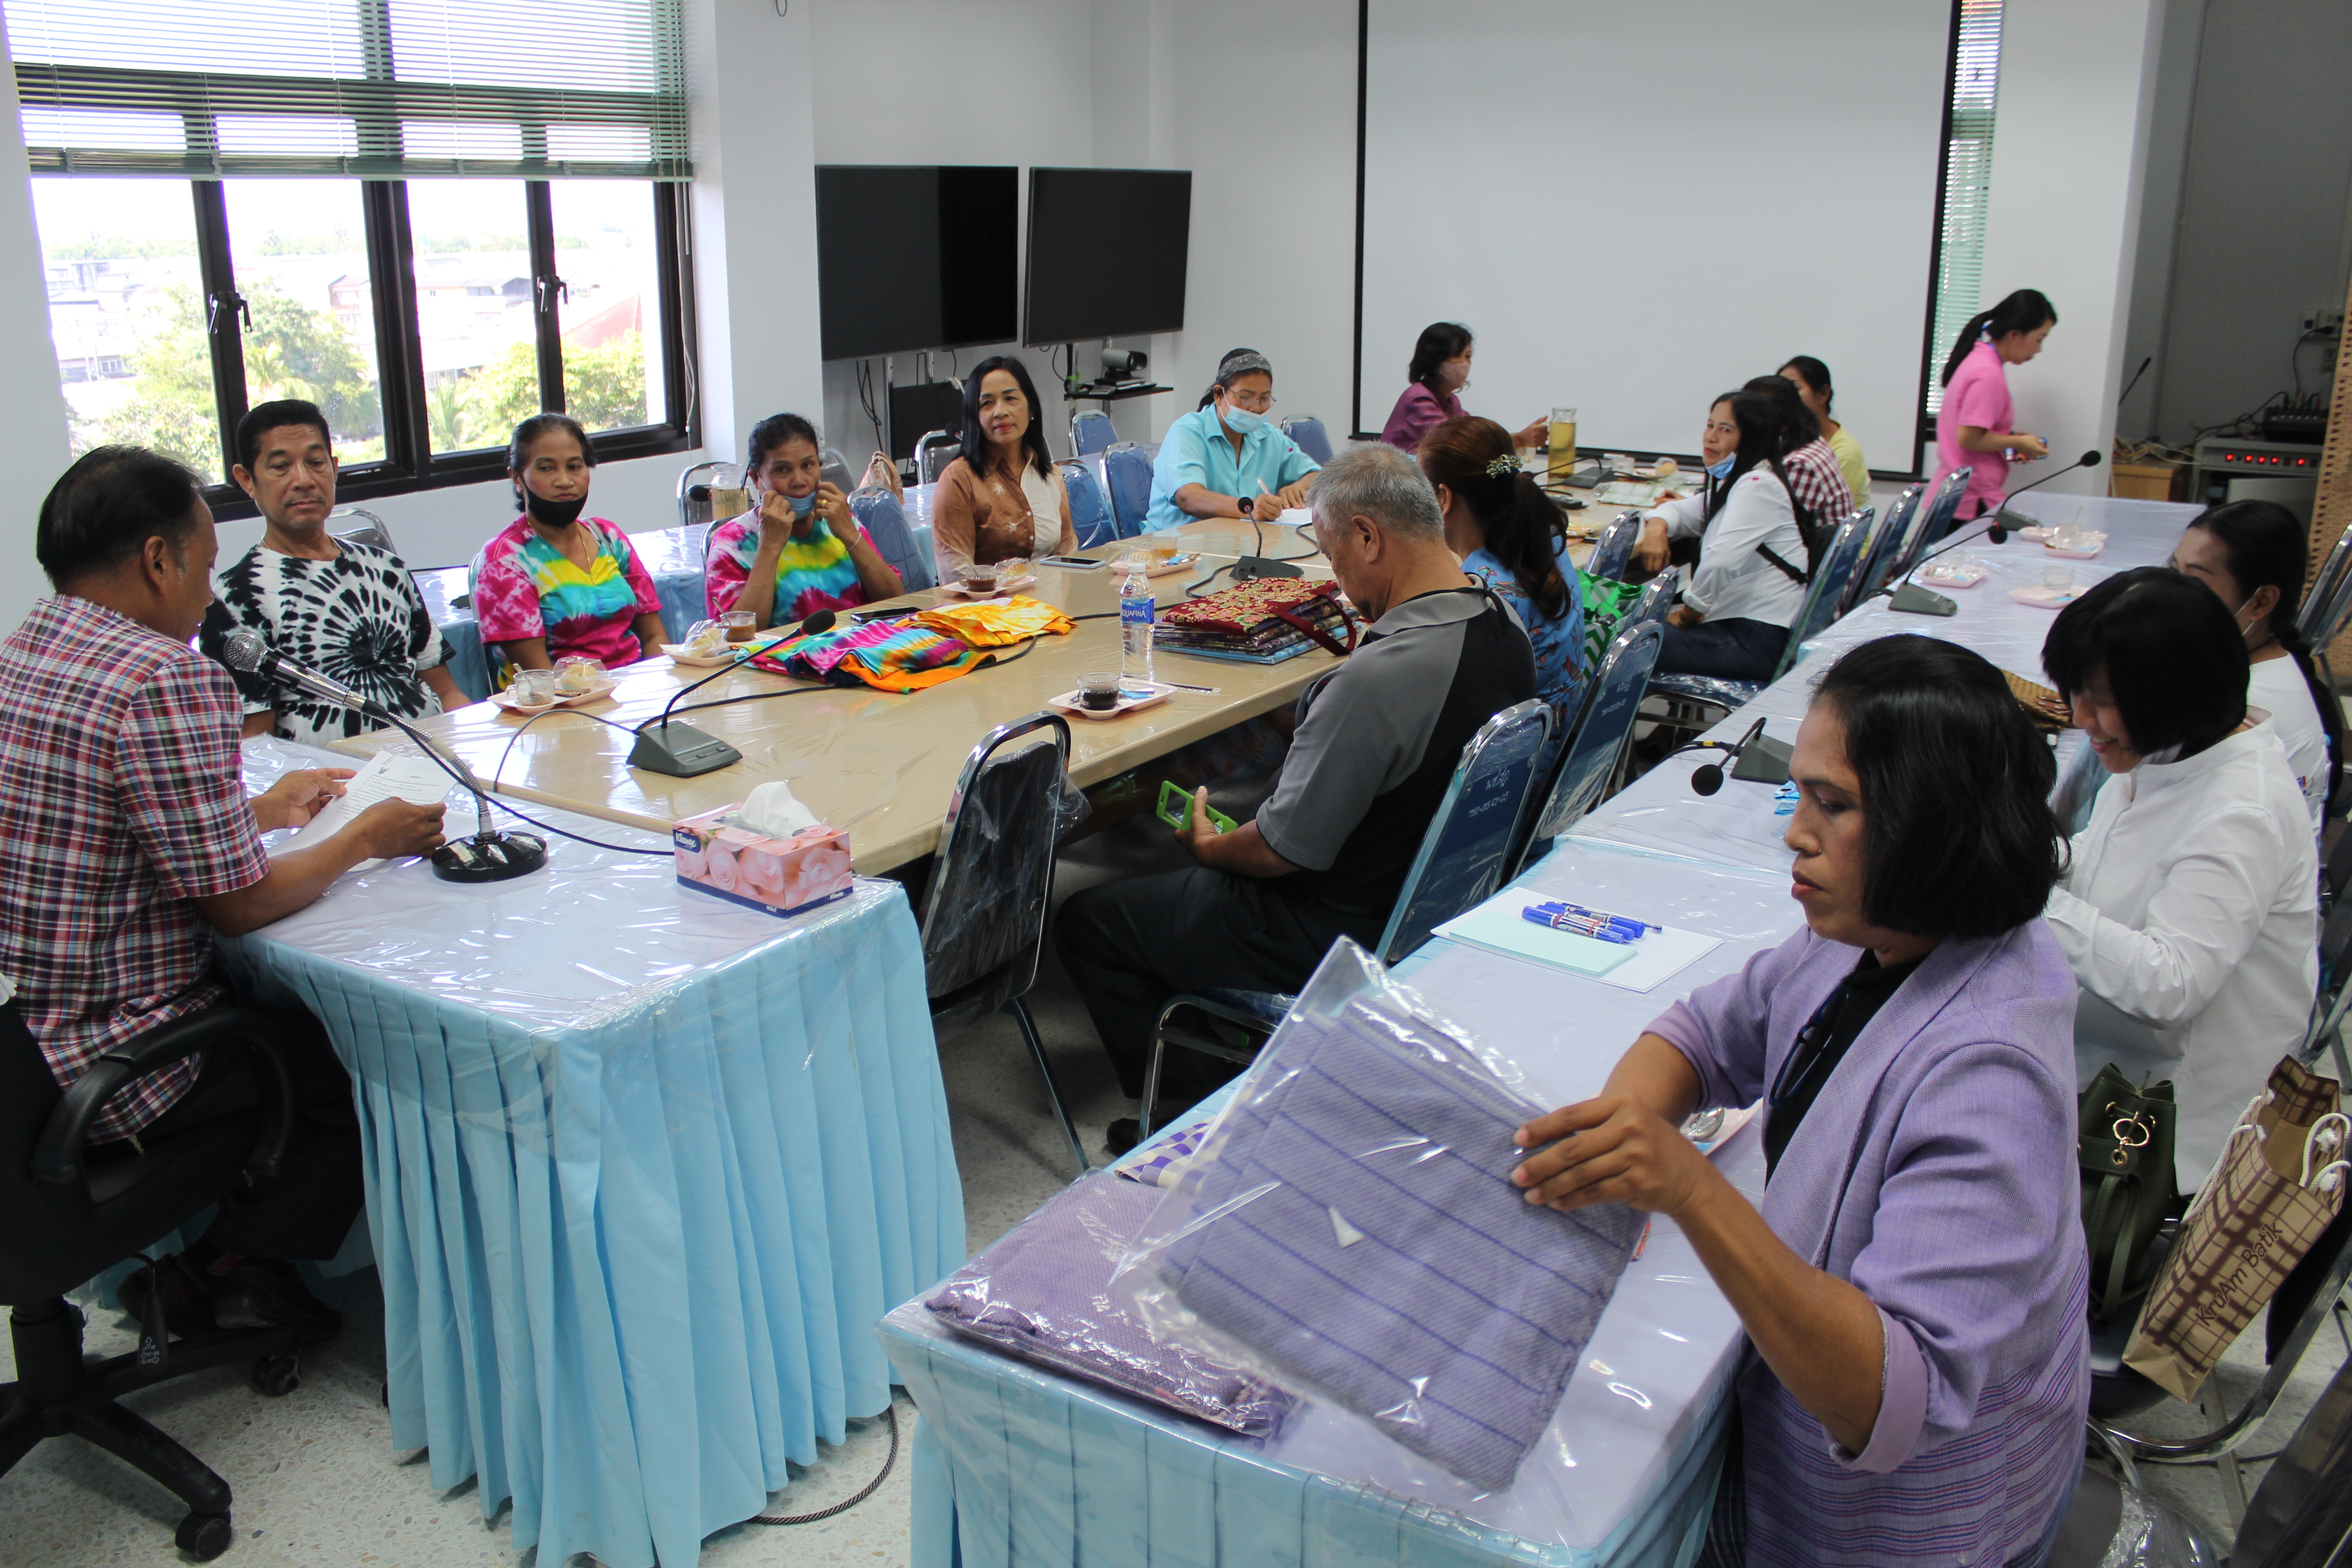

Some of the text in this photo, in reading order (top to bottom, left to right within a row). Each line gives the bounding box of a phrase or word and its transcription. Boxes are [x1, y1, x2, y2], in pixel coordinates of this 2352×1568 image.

[675, 833, 696, 848] Kleenex
[2195, 1222, 2283, 1326] KruAm Batik
